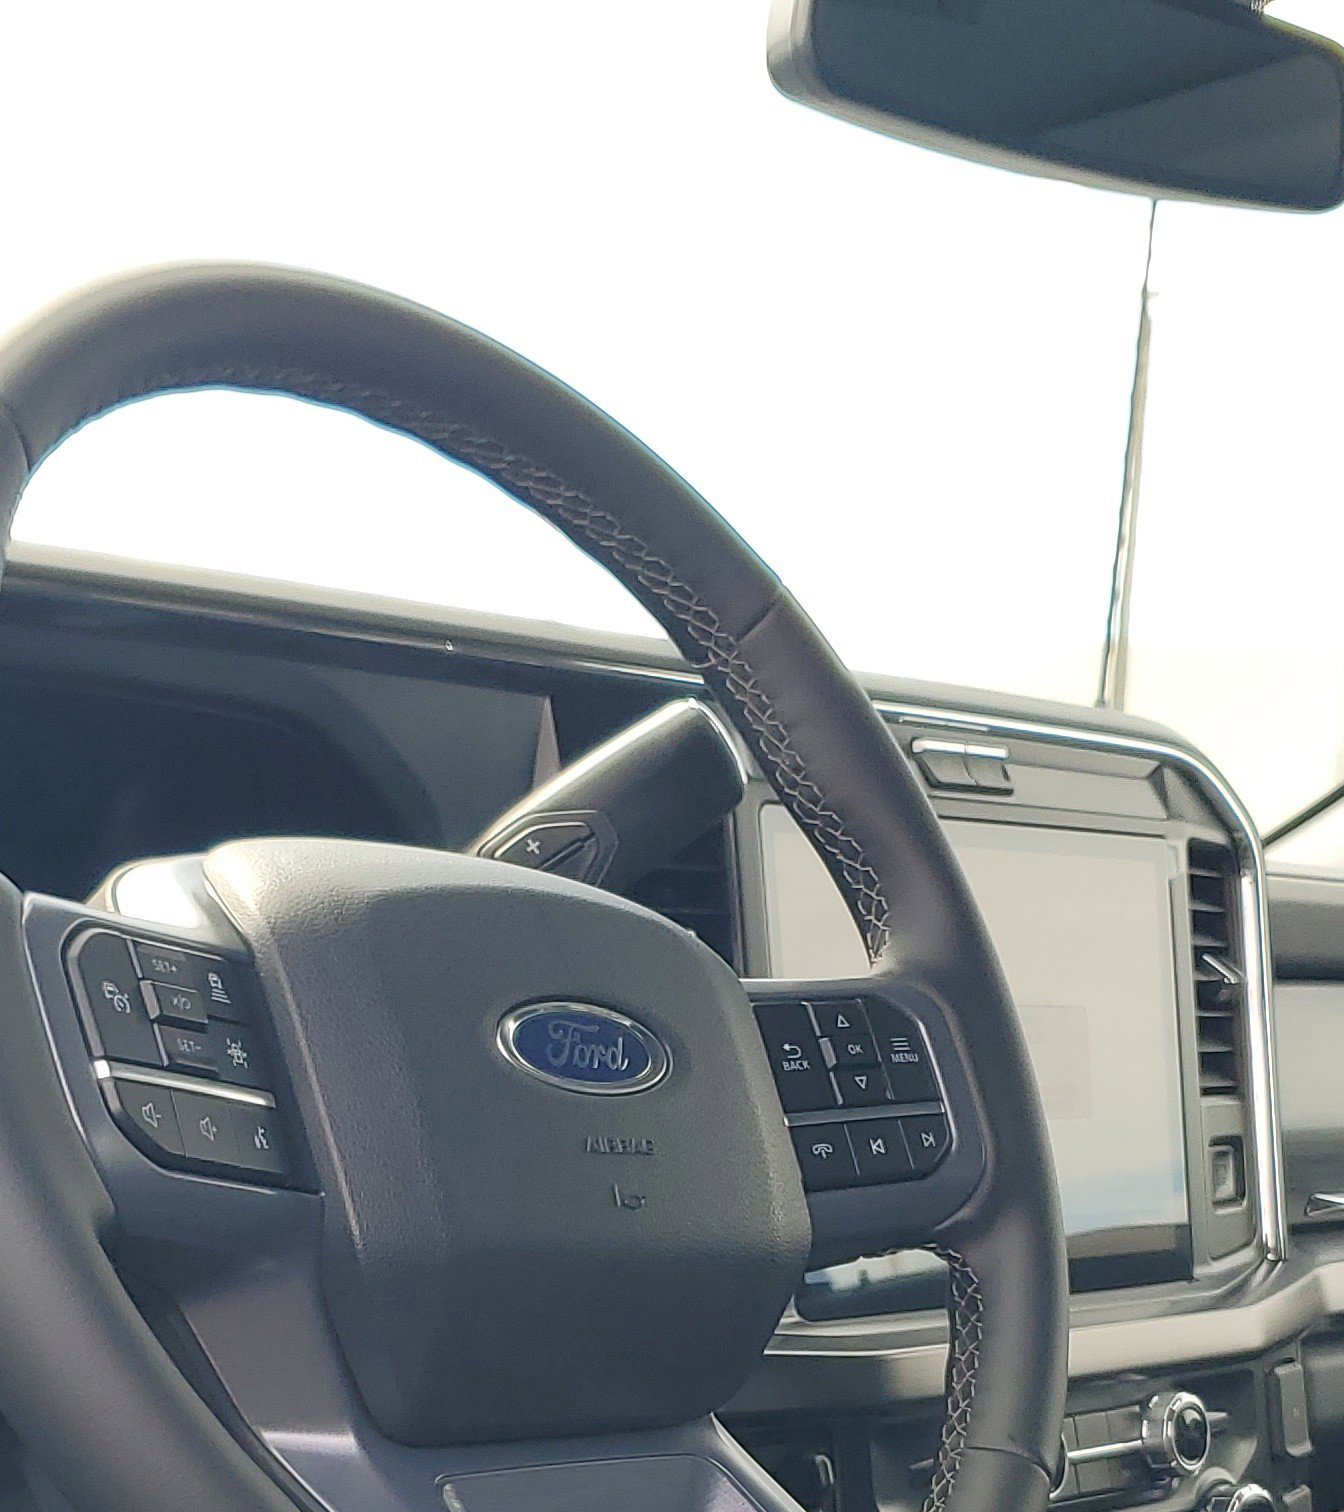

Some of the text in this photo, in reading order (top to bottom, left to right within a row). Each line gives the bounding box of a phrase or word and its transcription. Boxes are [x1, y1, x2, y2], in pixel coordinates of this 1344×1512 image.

[546, 1020, 630, 1071] Ford
[847, 1044, 863, 1055] OK
[890, 1053, 919, 1063] MENU
[782, 1060, 810, 1071] BACK
